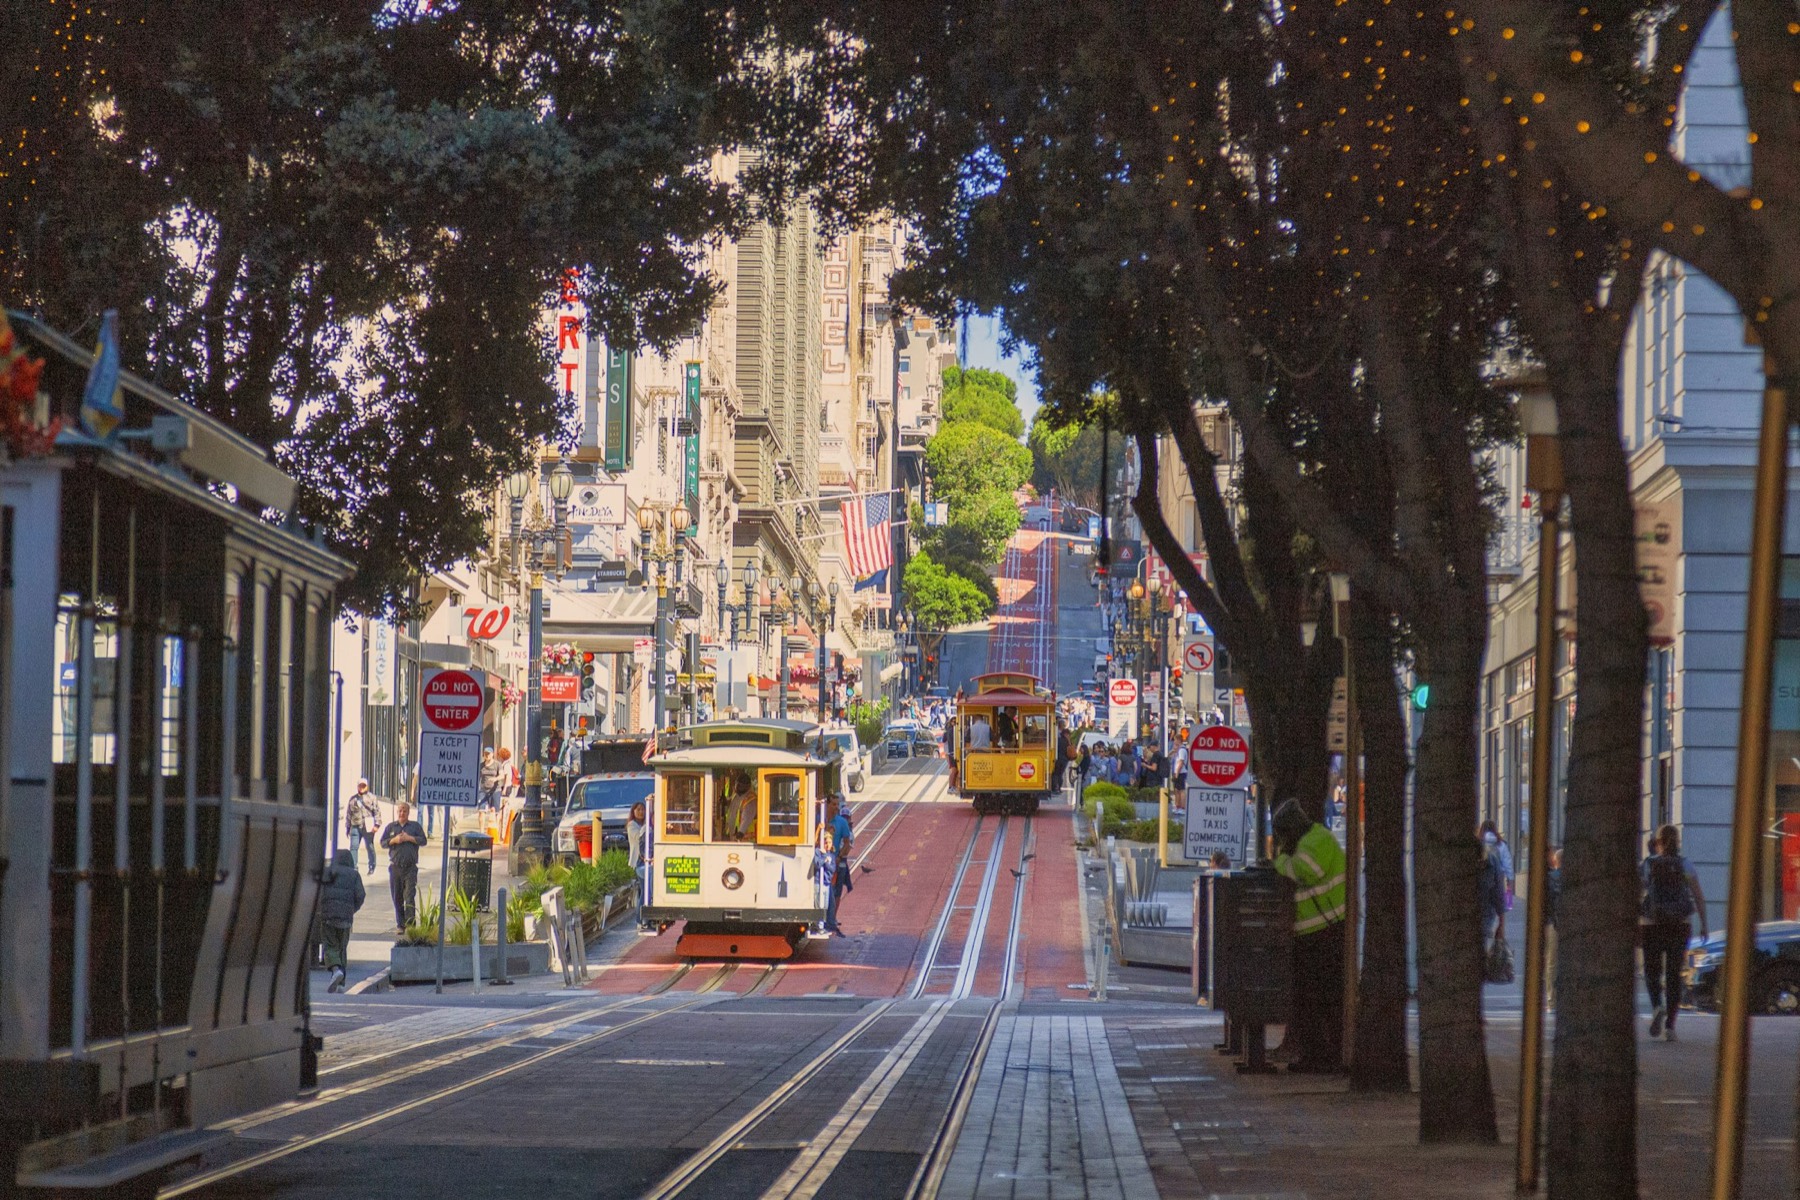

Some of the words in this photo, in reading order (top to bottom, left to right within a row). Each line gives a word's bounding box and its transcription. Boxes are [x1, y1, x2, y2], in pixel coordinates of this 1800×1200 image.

[823, 236, 848, 373] HOTEL
[505, 651, 528, 660] JINS
[650, 673, 675, 685] UG
[432, 681, 447, 691] DO
[453, 682, 475, 693] NOT
[435, 708, 469, 720] ENTER
[433, 737, 468, 747] EXCEPT
[1198, 736, 1214, 747] DO
[1220, 737, 1241, 749] NOT
[439, 751, 462, 761] MUNI
[437, 764, 462, 774] TAXIS
[1201, 764, 1235, 775] ENTER
[422, 776, 475, 789] COMMERCIAL
[426, 790, 470, 801] VEHICLES
[1200, 792, 1234, 803] EXCEPT
[1205, 806, 1227, 816] MUNI
[1203, 819, 1229, 830] TAXIS
[1188, 832, 1240, 844] COMMERCIAL
[727, 853, 740, 864] 8
